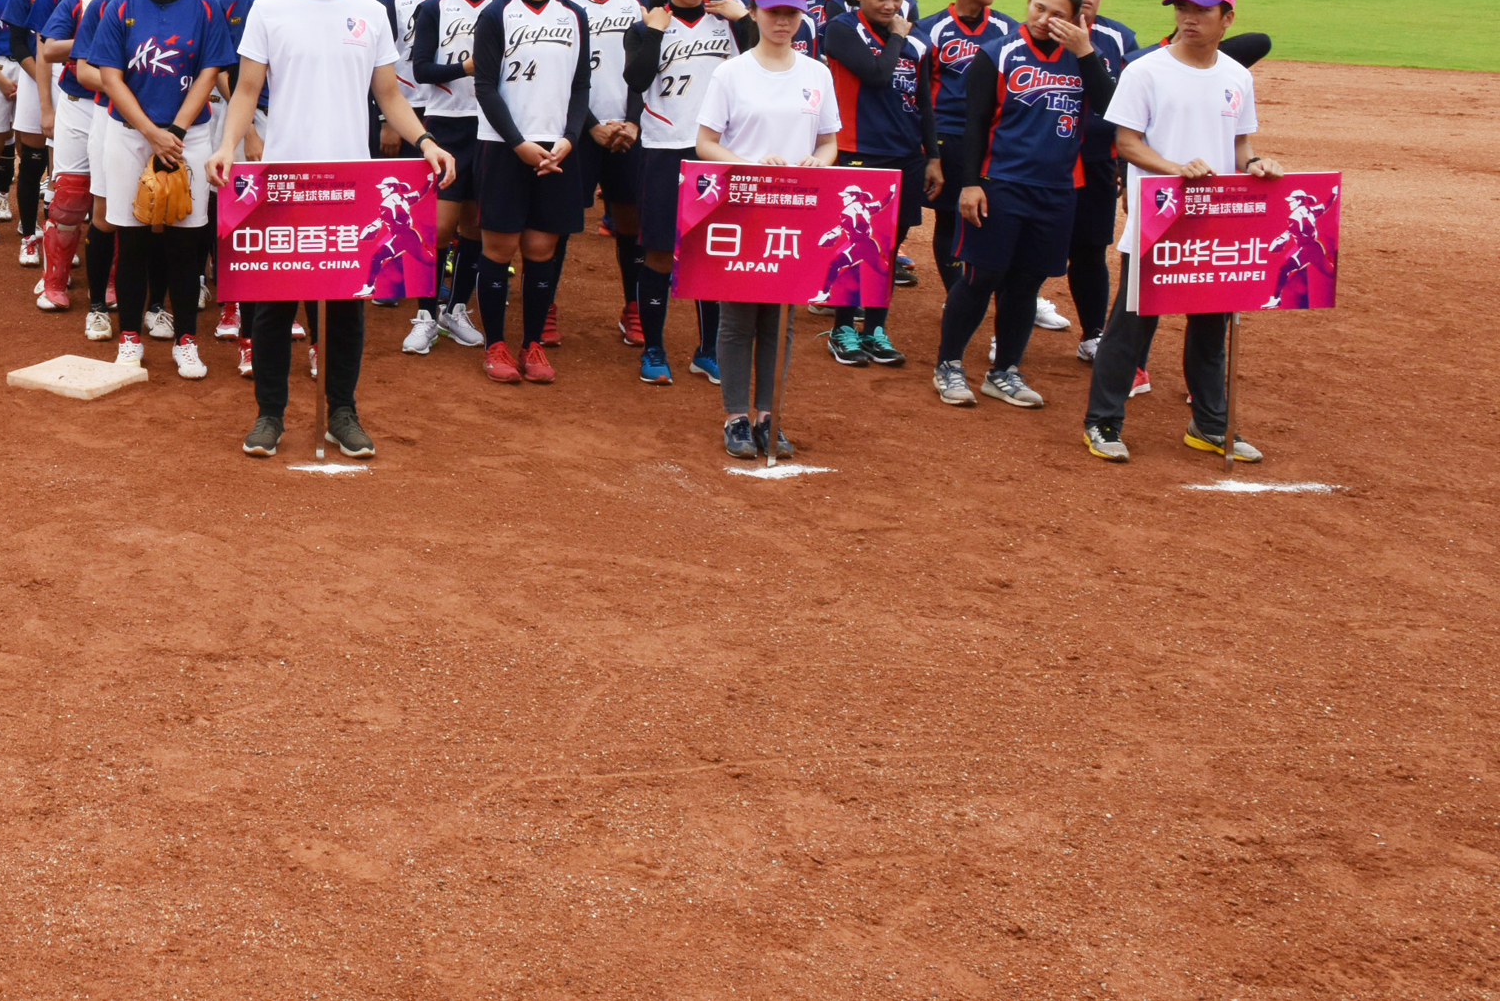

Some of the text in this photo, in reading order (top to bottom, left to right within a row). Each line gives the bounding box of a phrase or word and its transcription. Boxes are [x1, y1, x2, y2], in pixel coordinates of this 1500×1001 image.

[505, 24, 573, 59] Japan
[127, 37, 180, 75] HK
[658, 37, 731, 74] Japan
[505, 59, 538, 82] 24
[1007, 65, 1083, 94] Chinese
[659, 75, 692, 98] 27
[1045, 91, 1081, 113] Taipe
[267, 189, 356, 202] 女子垒球锦标赛
[728, 191, 818, 206] 女子垒球锦标赛
[1184, 202, 1267, 215] 女子垒球锦标赛
[232, 225, 359, 254] 中国香港
[706, 223, 802, 259] 日本
[1152, 237, 1268, 267] 中华台北
[230, 261, 360, 271] HONG KONG, CHINA
[724, 261, 779, 273] JAPAN
[1152, 271, 1266, 285] CHINESE TAIPEI
